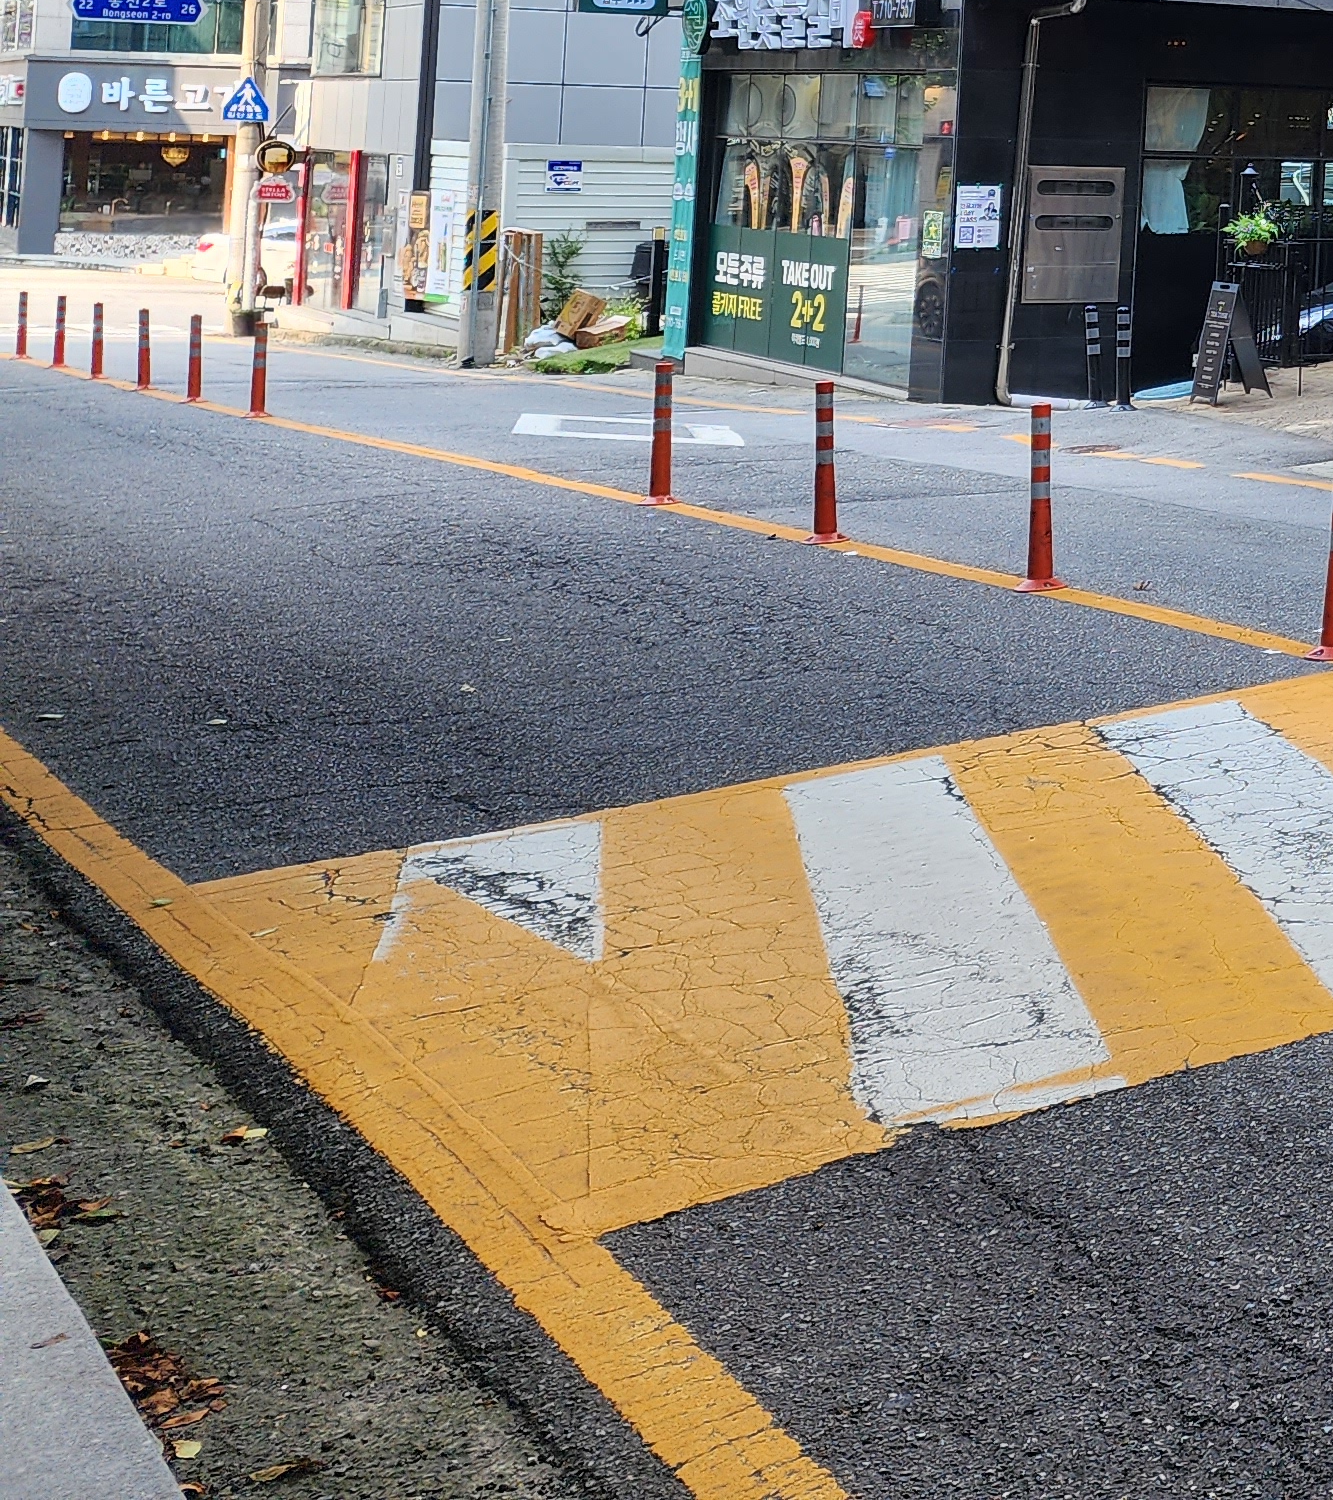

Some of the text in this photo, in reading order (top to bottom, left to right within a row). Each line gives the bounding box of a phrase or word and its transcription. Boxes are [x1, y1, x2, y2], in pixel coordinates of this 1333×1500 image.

[78, 0, 94, 10] 22
[102, 8, 171, 20] Bongseon 2-ro
[180, 3, 196, 15] 26
[714, 251, 766, 290] 모든주류
[781, 259, 837, 291] TAKE OUT
[712, 291, 763, 321] 콜키지 FREE
[790, 290, 826, 332] 2+2
